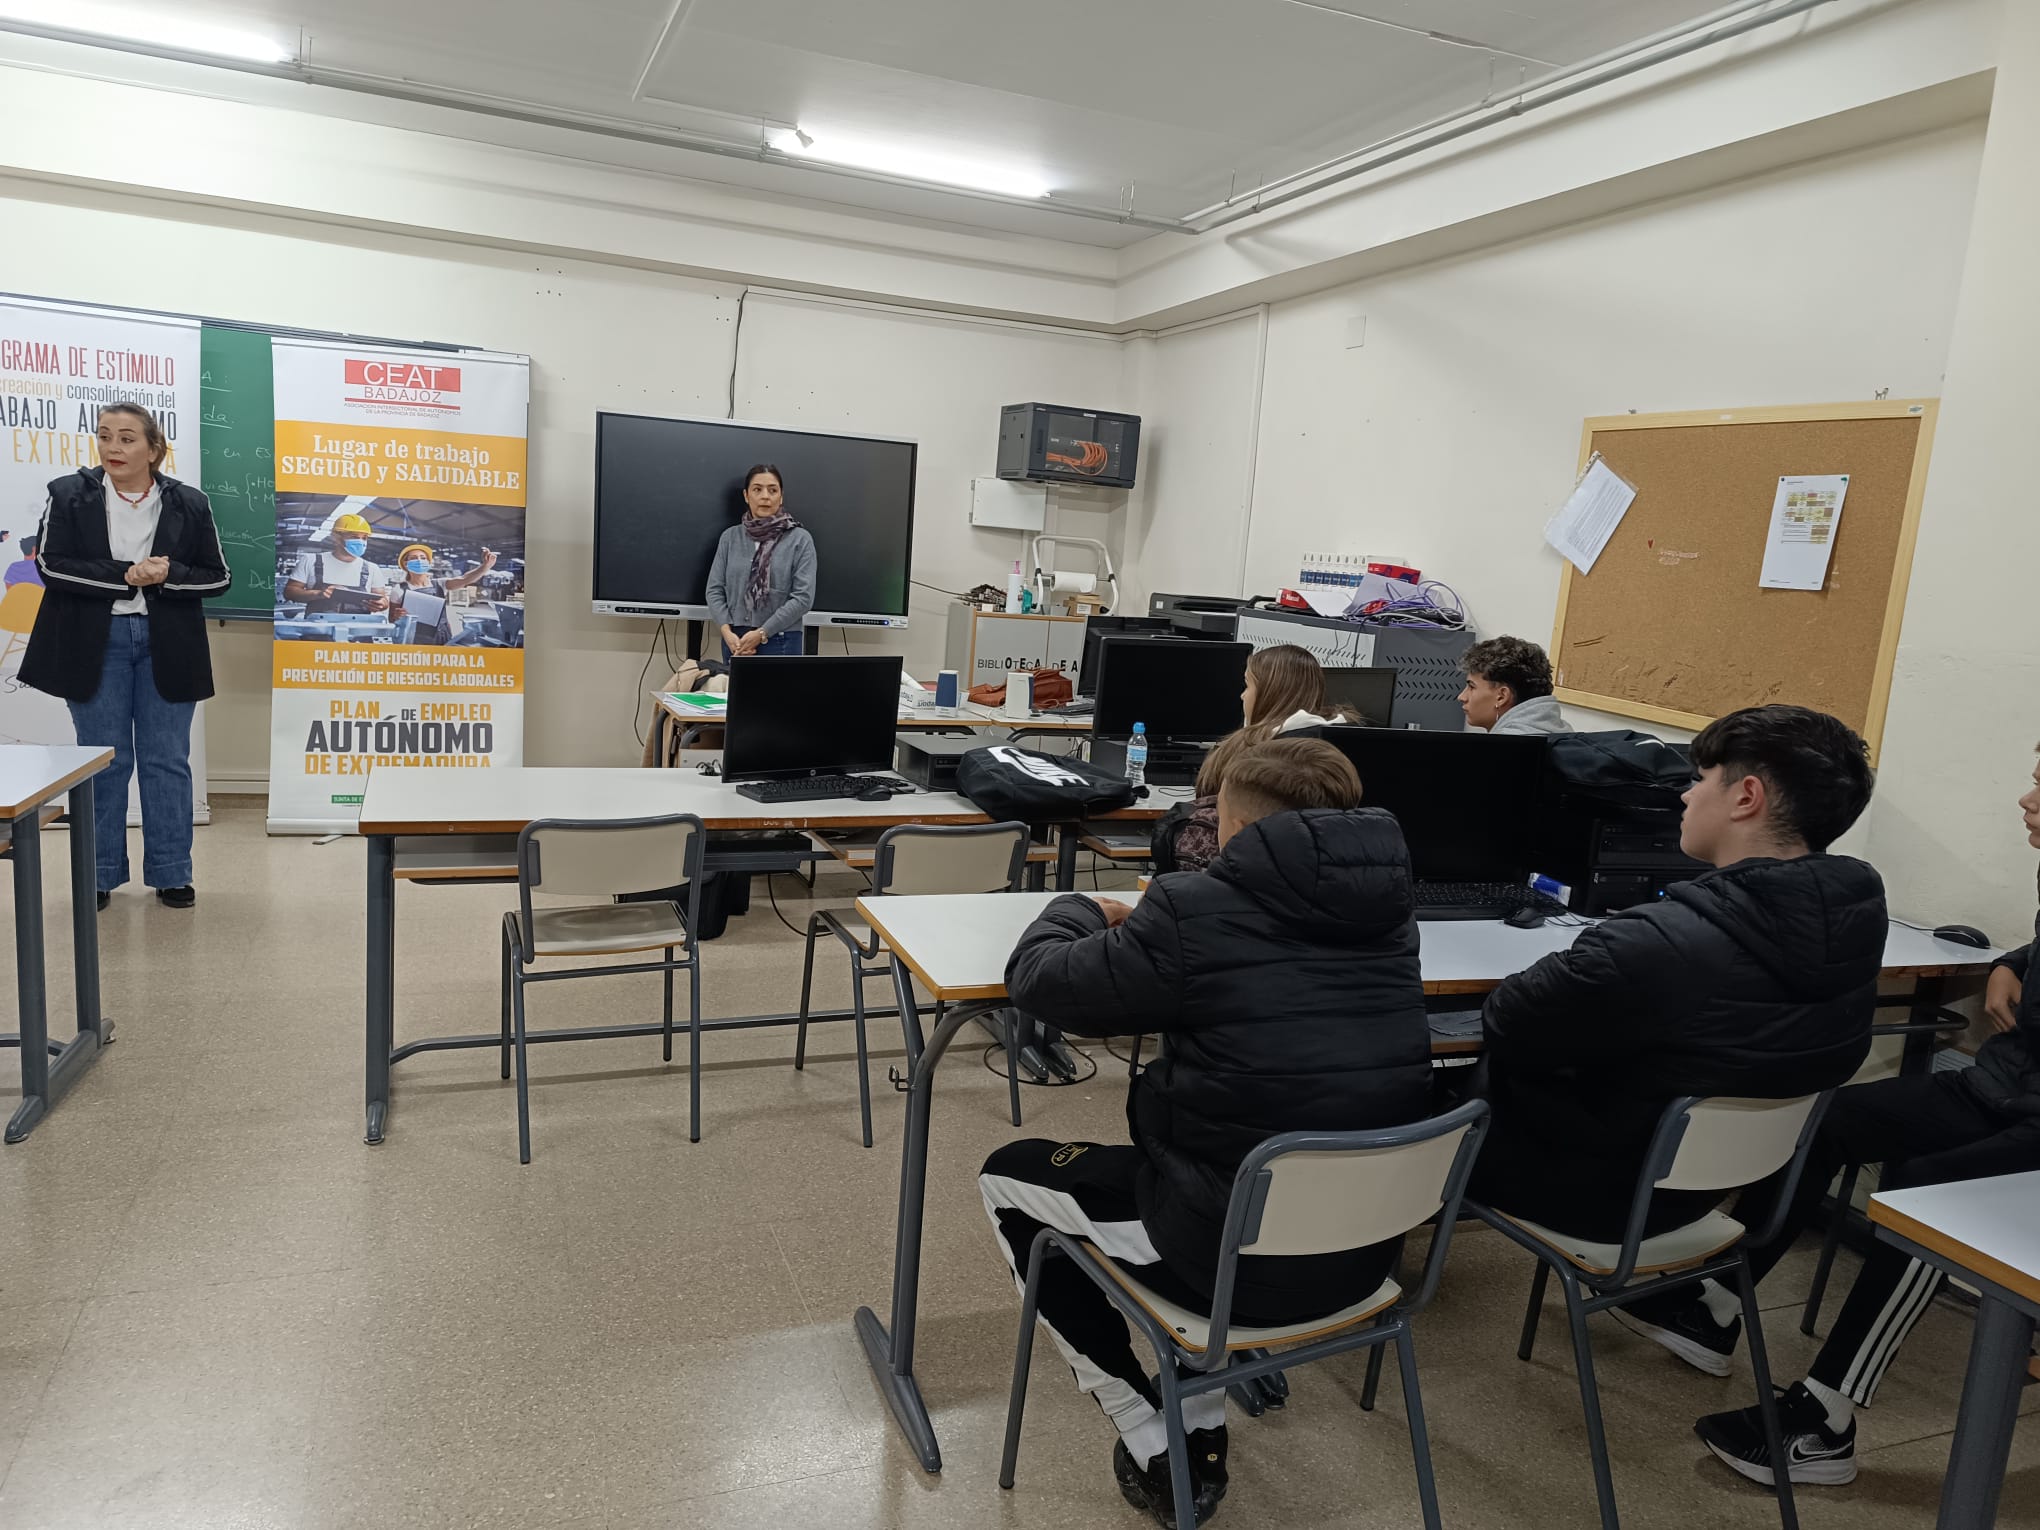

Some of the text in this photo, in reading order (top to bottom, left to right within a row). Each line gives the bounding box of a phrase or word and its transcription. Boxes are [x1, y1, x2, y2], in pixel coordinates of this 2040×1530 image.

[69, 346, 89, 378] DE
[97, 348, 175, 387] ESTÍMULO
[363, 362, 443, 389] CEAT
[55, 384, 63, 400] y
[67, 384, 153, 407] consolidación
[157, 390, 175, 409] del
[364, 386, 442, 403] BADAJOZ
[313, 434, 490, 468] Lugar de trabajo
[281, 455, 520, 490] SEGURO y SALUDABLE
[314, 649, 486, 669] PLAN DE DIFUSIÓN PARA LA
[977, 656, 1041, 671] BIBLIOTECA
[282, 667, 515, 688] PREVENCIÓN DE RIESGOS LABORALES
[330, 700, 492, 721] PLAN DE EMPLEO
[305, 715, 493, 754] AUTÓNOMO
[304, 754, 332, 775] DE
